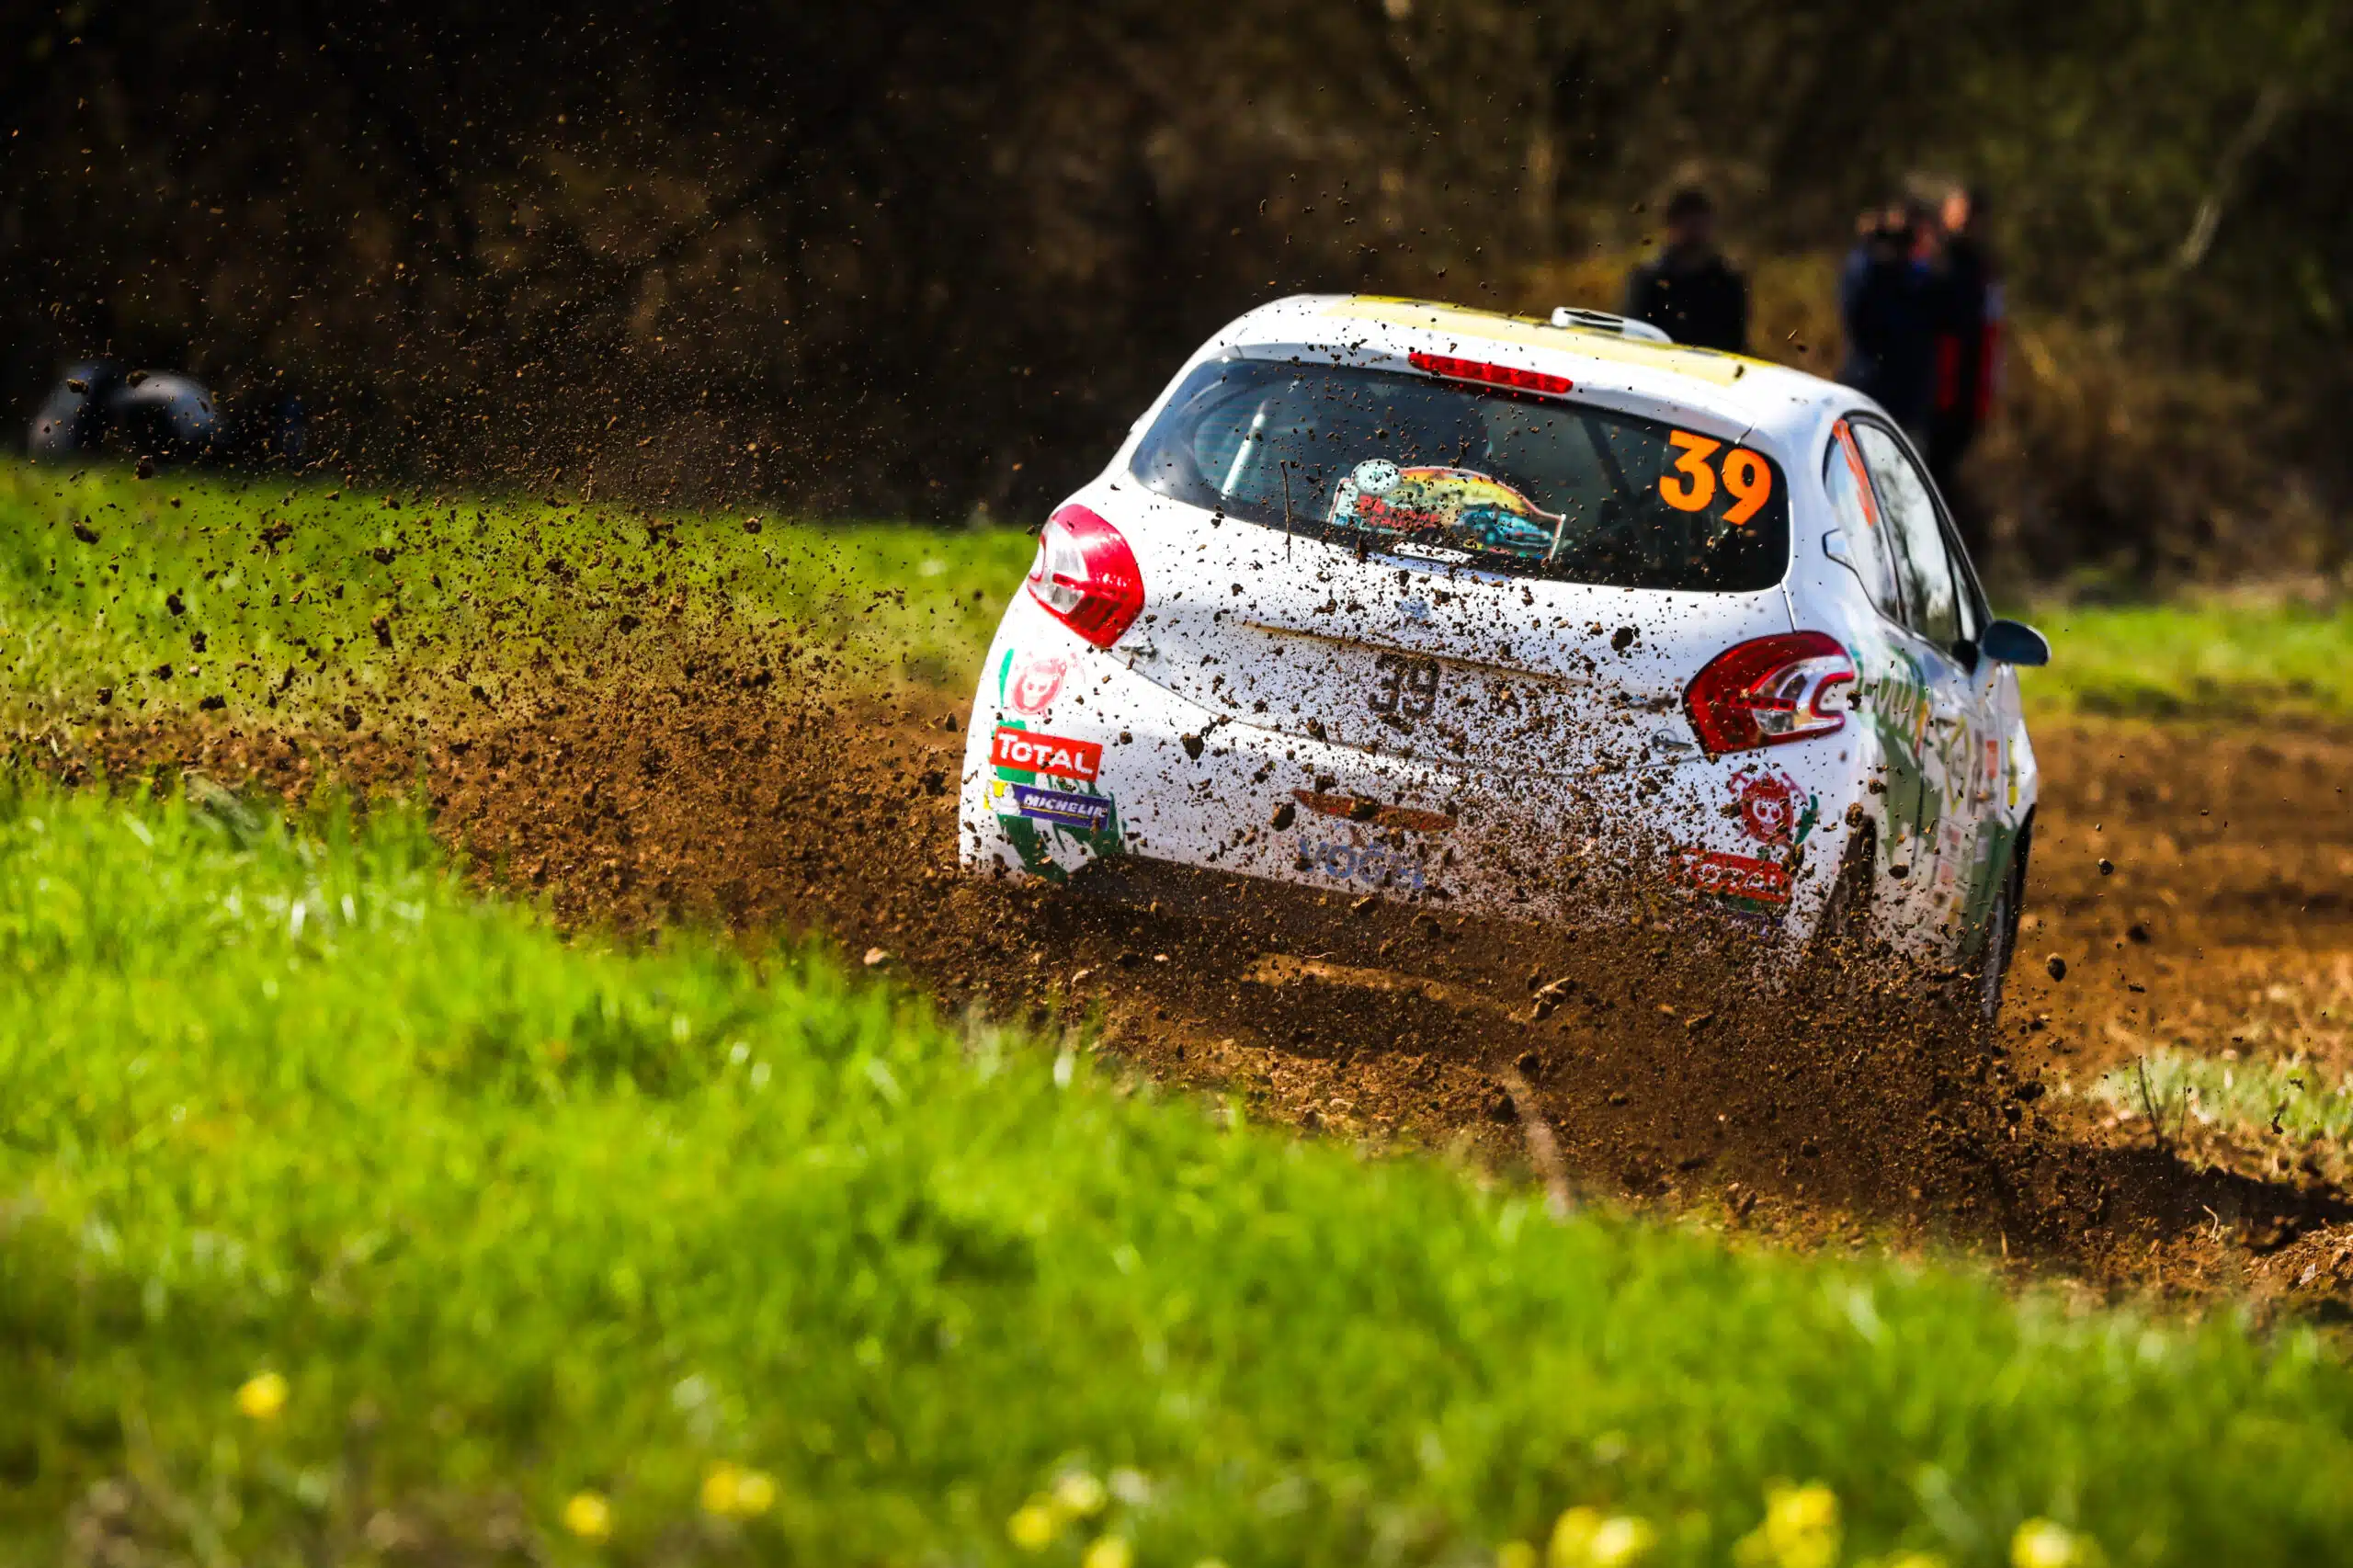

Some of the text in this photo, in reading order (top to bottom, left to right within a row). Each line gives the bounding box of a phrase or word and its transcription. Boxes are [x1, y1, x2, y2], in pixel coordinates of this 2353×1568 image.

[1659, 429, 1772, 526] 39
[1368, 653, 1439, 717] 39
[997, 733, 1094, 775] TOTAL
[1023, 793, 1108, 818] MICHELIN
